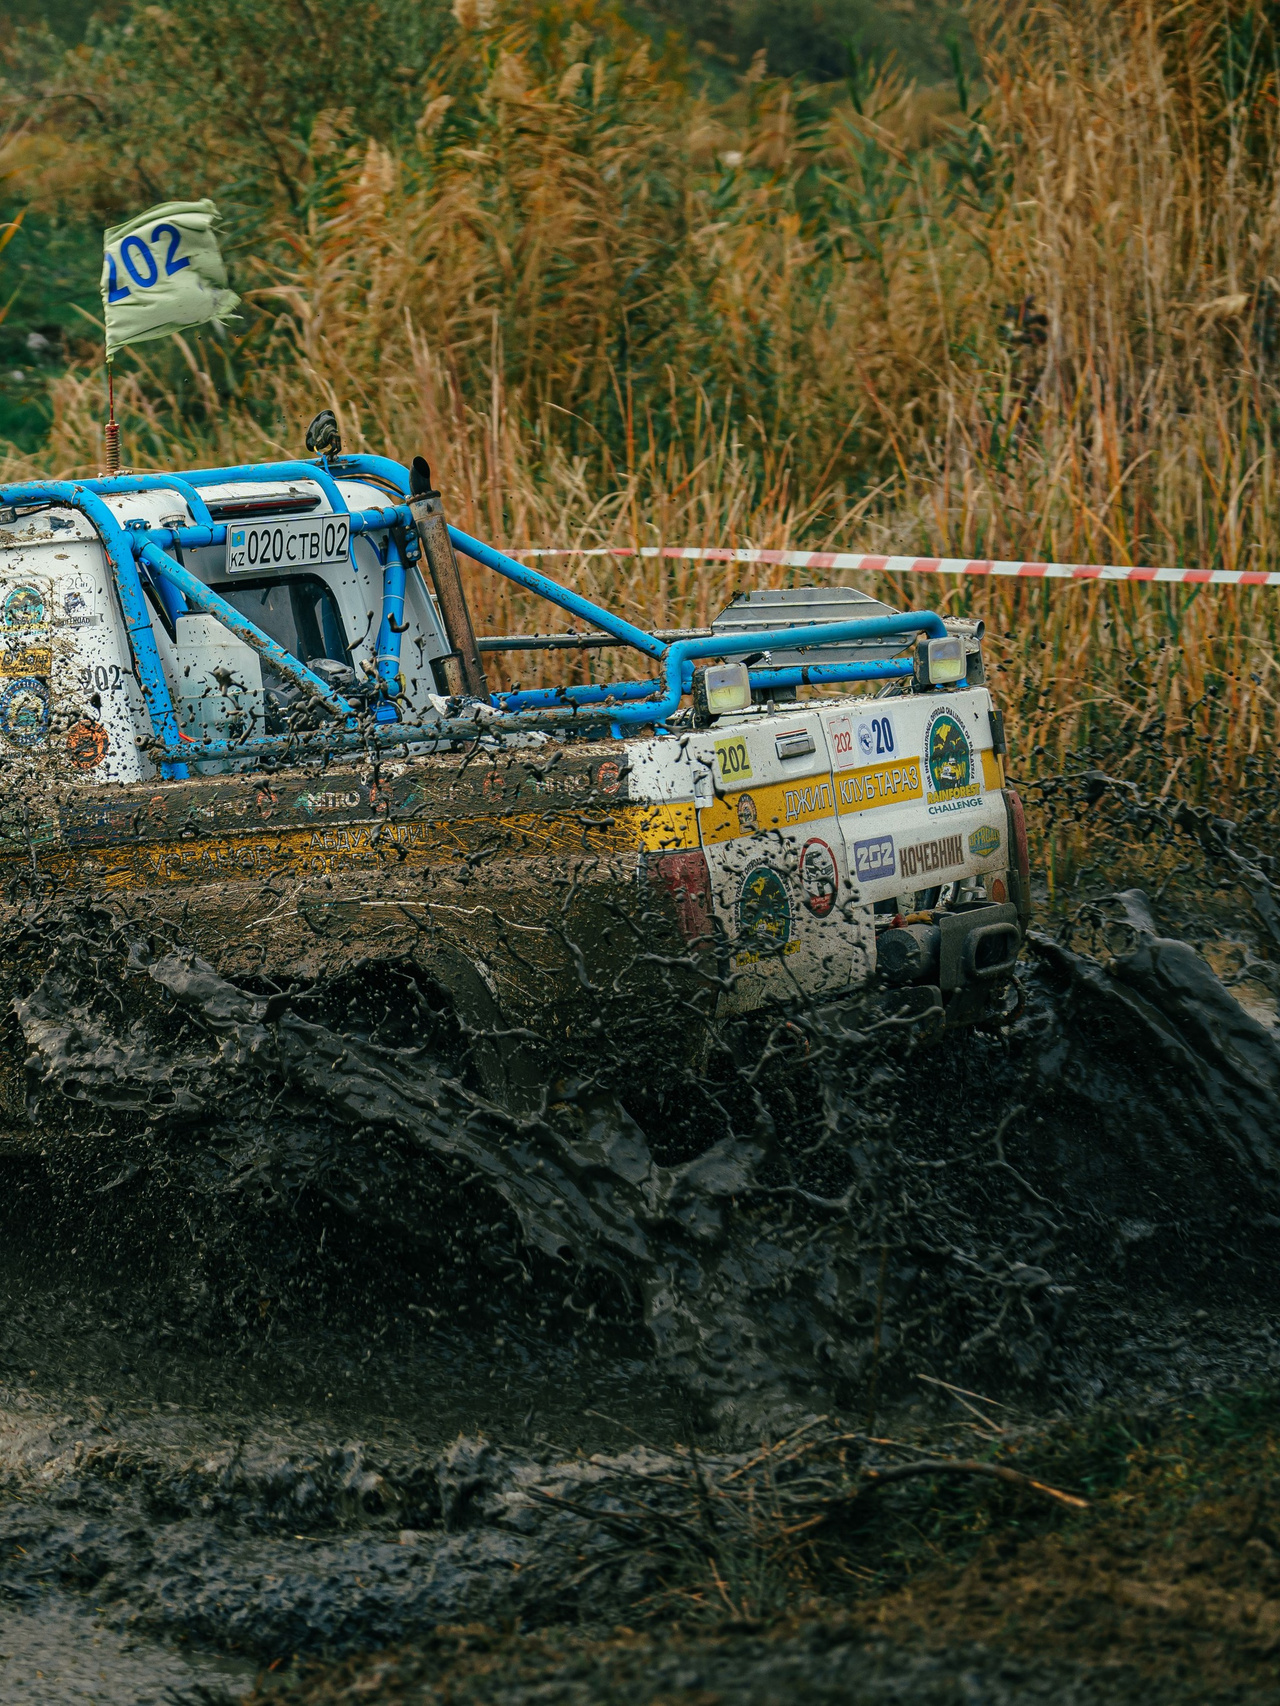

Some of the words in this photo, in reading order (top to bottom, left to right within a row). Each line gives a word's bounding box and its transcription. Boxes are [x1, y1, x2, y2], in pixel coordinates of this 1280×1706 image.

[105, 223, 191, 303] 202
[231, 552, 245, 567] KZ
[324, 522, 348, 557] 02
[80, 664, 123, 695] 202
[834, 731, 852, 753] 202
[871, 717, 894, 754] 20
[718, 744, 749, 775] 202
[785, 783, 832, 822] ДЖИП
[839, 775, 875, 804] КЛУБ
[874, 765, 919, 796] ТАРАЗ
[927, 782, 981, 805] RAINFOREST
[928, 797, 983, 815] CHALLENGE
[969, 827, 1000, 847] OFFROAD
[857, 841, 894, 872] 202
[899, 833, 964, 878] КОЧЕВНИК
